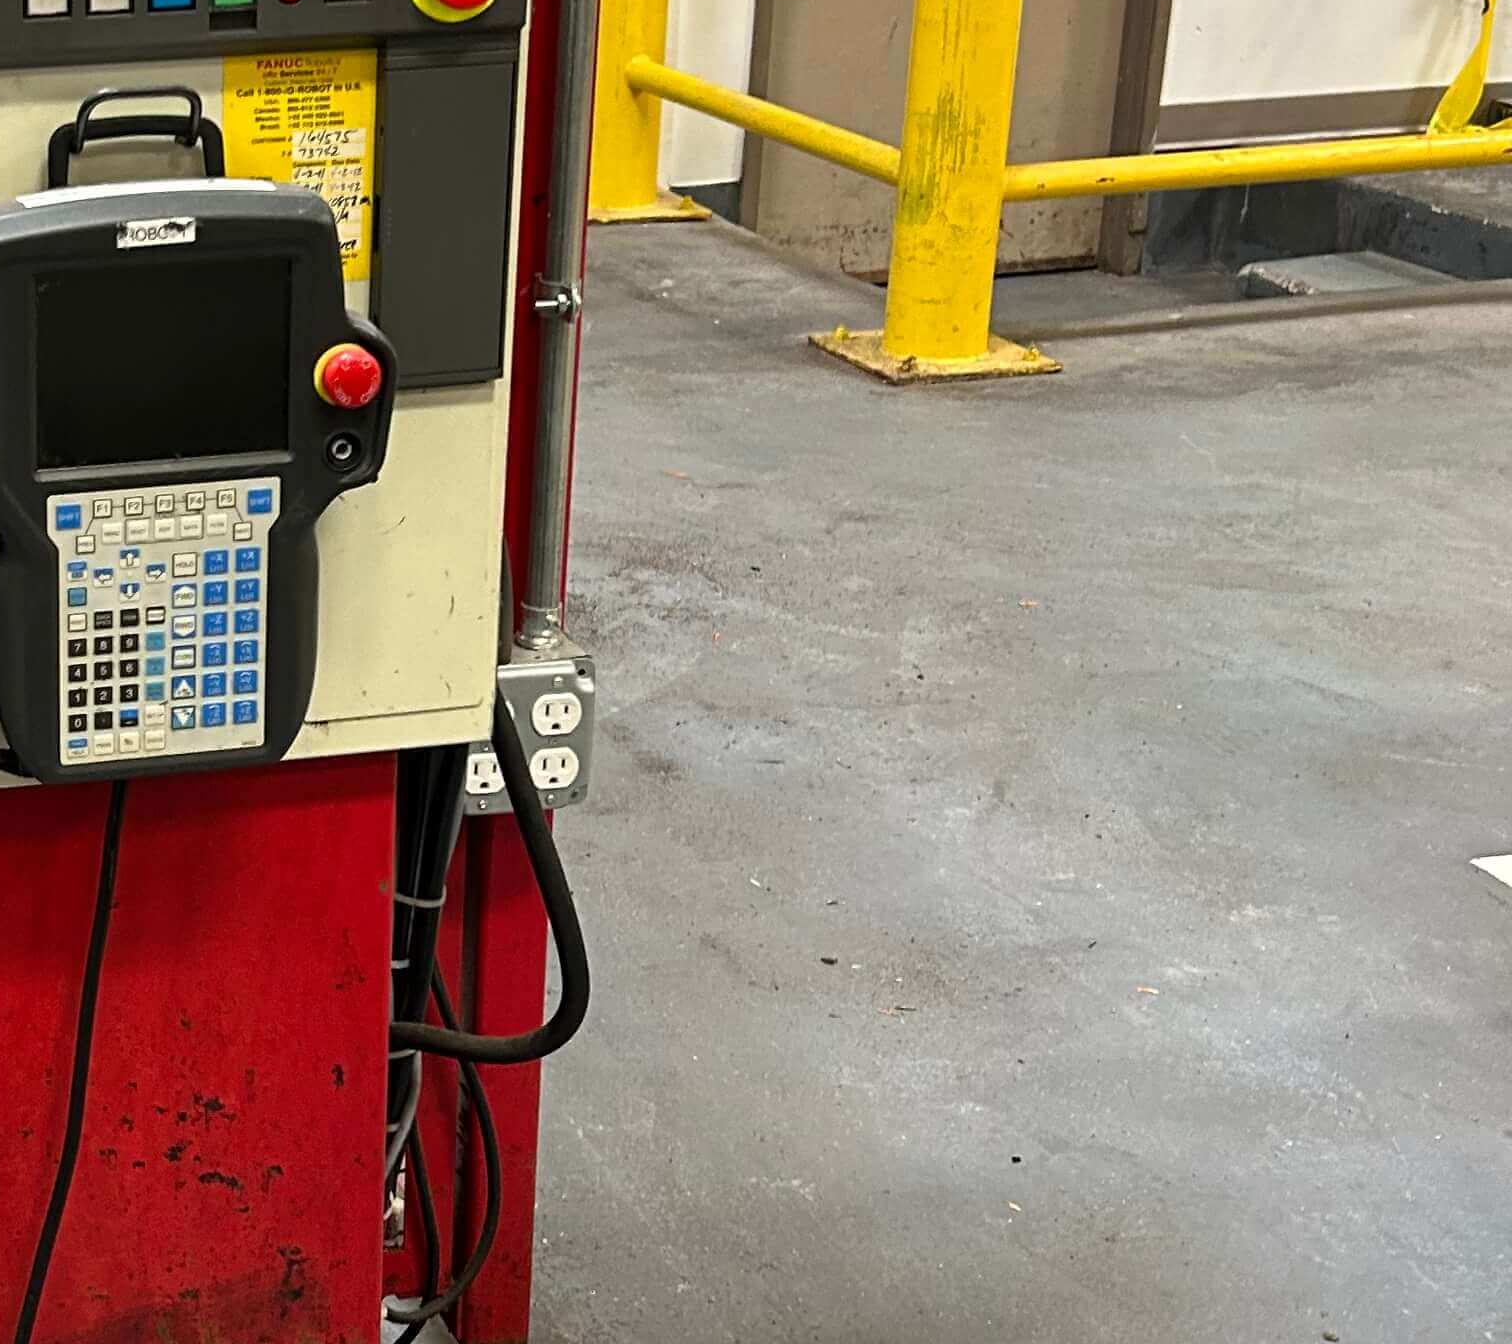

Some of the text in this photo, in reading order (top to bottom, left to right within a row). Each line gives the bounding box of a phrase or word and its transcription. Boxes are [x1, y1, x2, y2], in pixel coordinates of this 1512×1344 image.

[255, 57, 304, 70] FANUC
[189, 496, 202, 506] F4
[220, 493, 233, 503] F5
[96, 504, 109, 514] F1
[127, 501, 140, 511] F2
[158, 499, 172, 509] F3
[74, 643, 81, 653] 7
[100, 640, 108, 649] 8
[126, 638, 134, 648] 9
[74, 668, 81, 677] 4
[100, 666, 108, 676] 5
[125, 664, 134, 673] 6
[99, 691, 108, 701] 2
[125, 689, 134, 698] 3
[74, 718, 82, 728] 0
